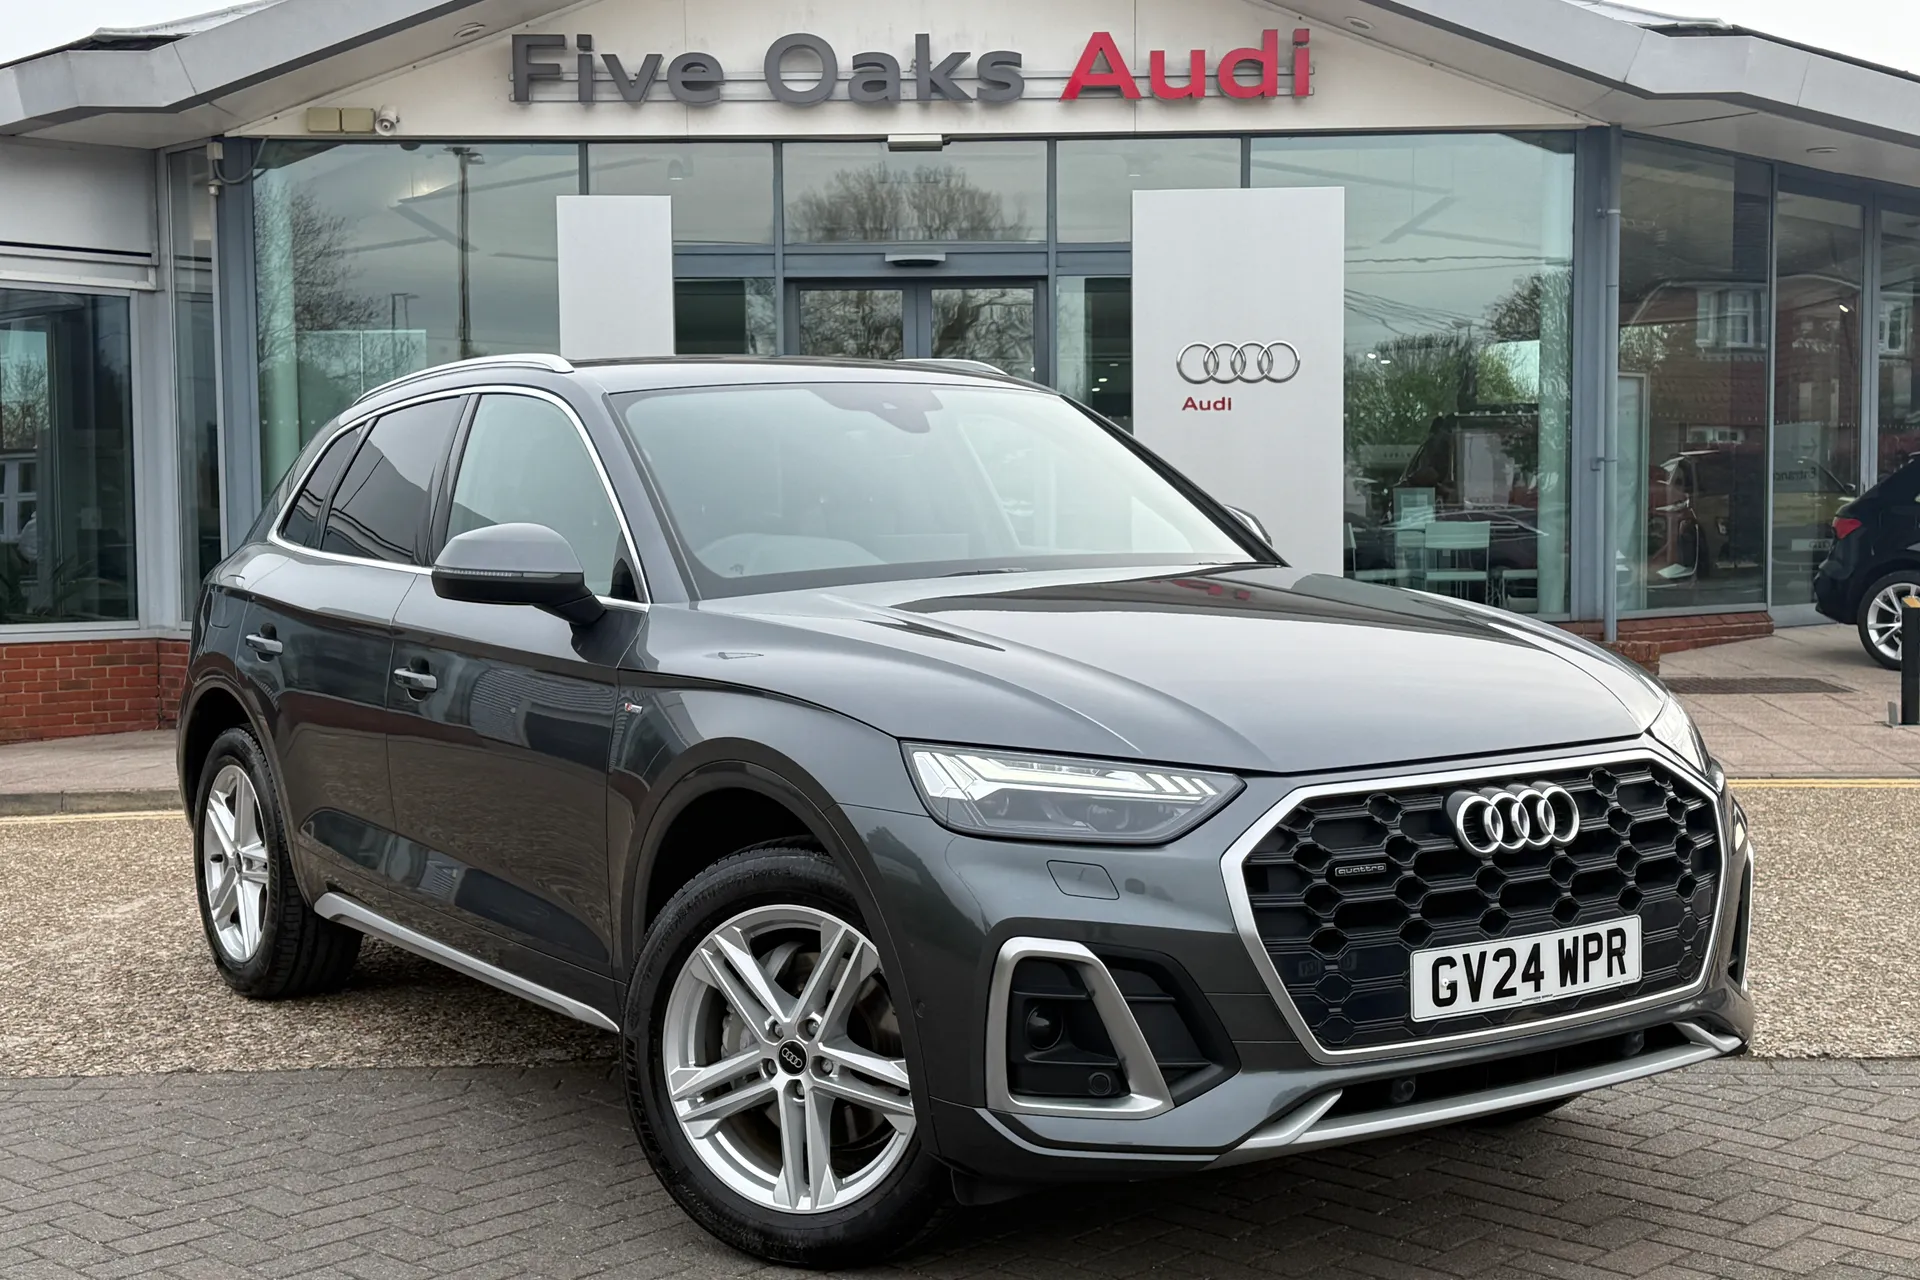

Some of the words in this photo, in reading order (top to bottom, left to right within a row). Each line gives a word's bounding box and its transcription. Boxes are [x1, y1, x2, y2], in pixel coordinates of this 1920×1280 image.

[512, 34, 725, 105] Five
[764, 33, 1025, 105] Oaks
[1059, 28, 1311, 101] Audi
[1182, 396, 1232, 411] Audi
[1338, 865, 1385, 875] quattro
[1431, 942, 1545, 1008] GV24
[1557, 927, 1627, 988] WPR
